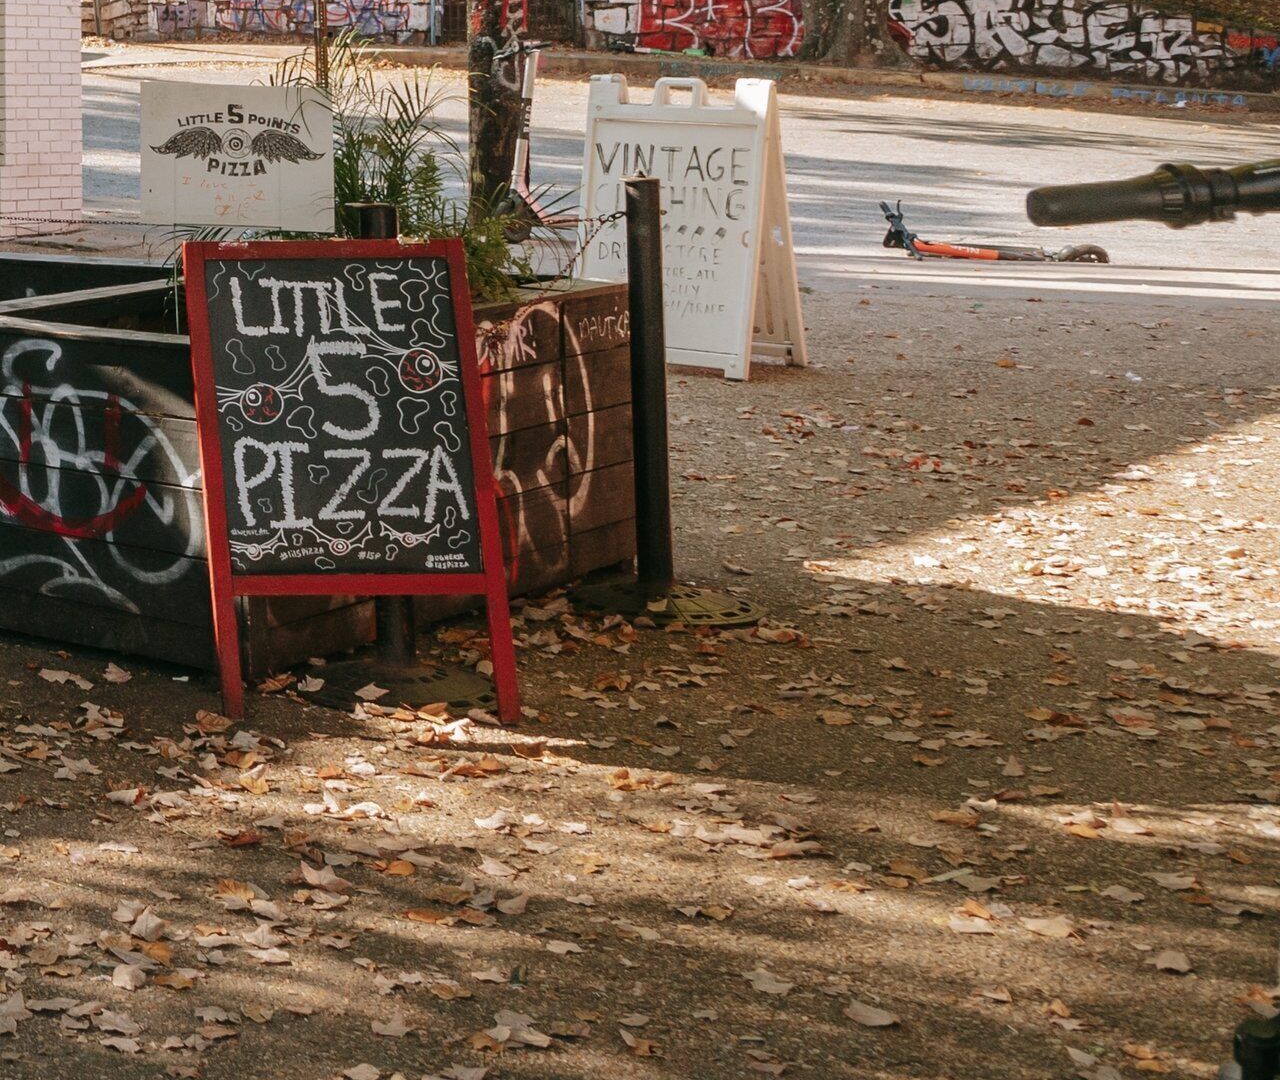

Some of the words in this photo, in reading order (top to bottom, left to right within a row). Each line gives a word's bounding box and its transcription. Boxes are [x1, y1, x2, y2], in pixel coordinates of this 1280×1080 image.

[177, 112, 224, 128] LITTLE
[227, 104, 244, 124] 5
[248, 113, 301, 135] POINTS
[206, 158, 267, 177] PIZZA
[595, 142, 752, 186] VINTAGE
[594, 184, 746, 221] CLHING
[228, 273, 407, 337] LITTLE
[307, 336, 380, 441] 5
[231, 436, 470, 530] PIZZA
